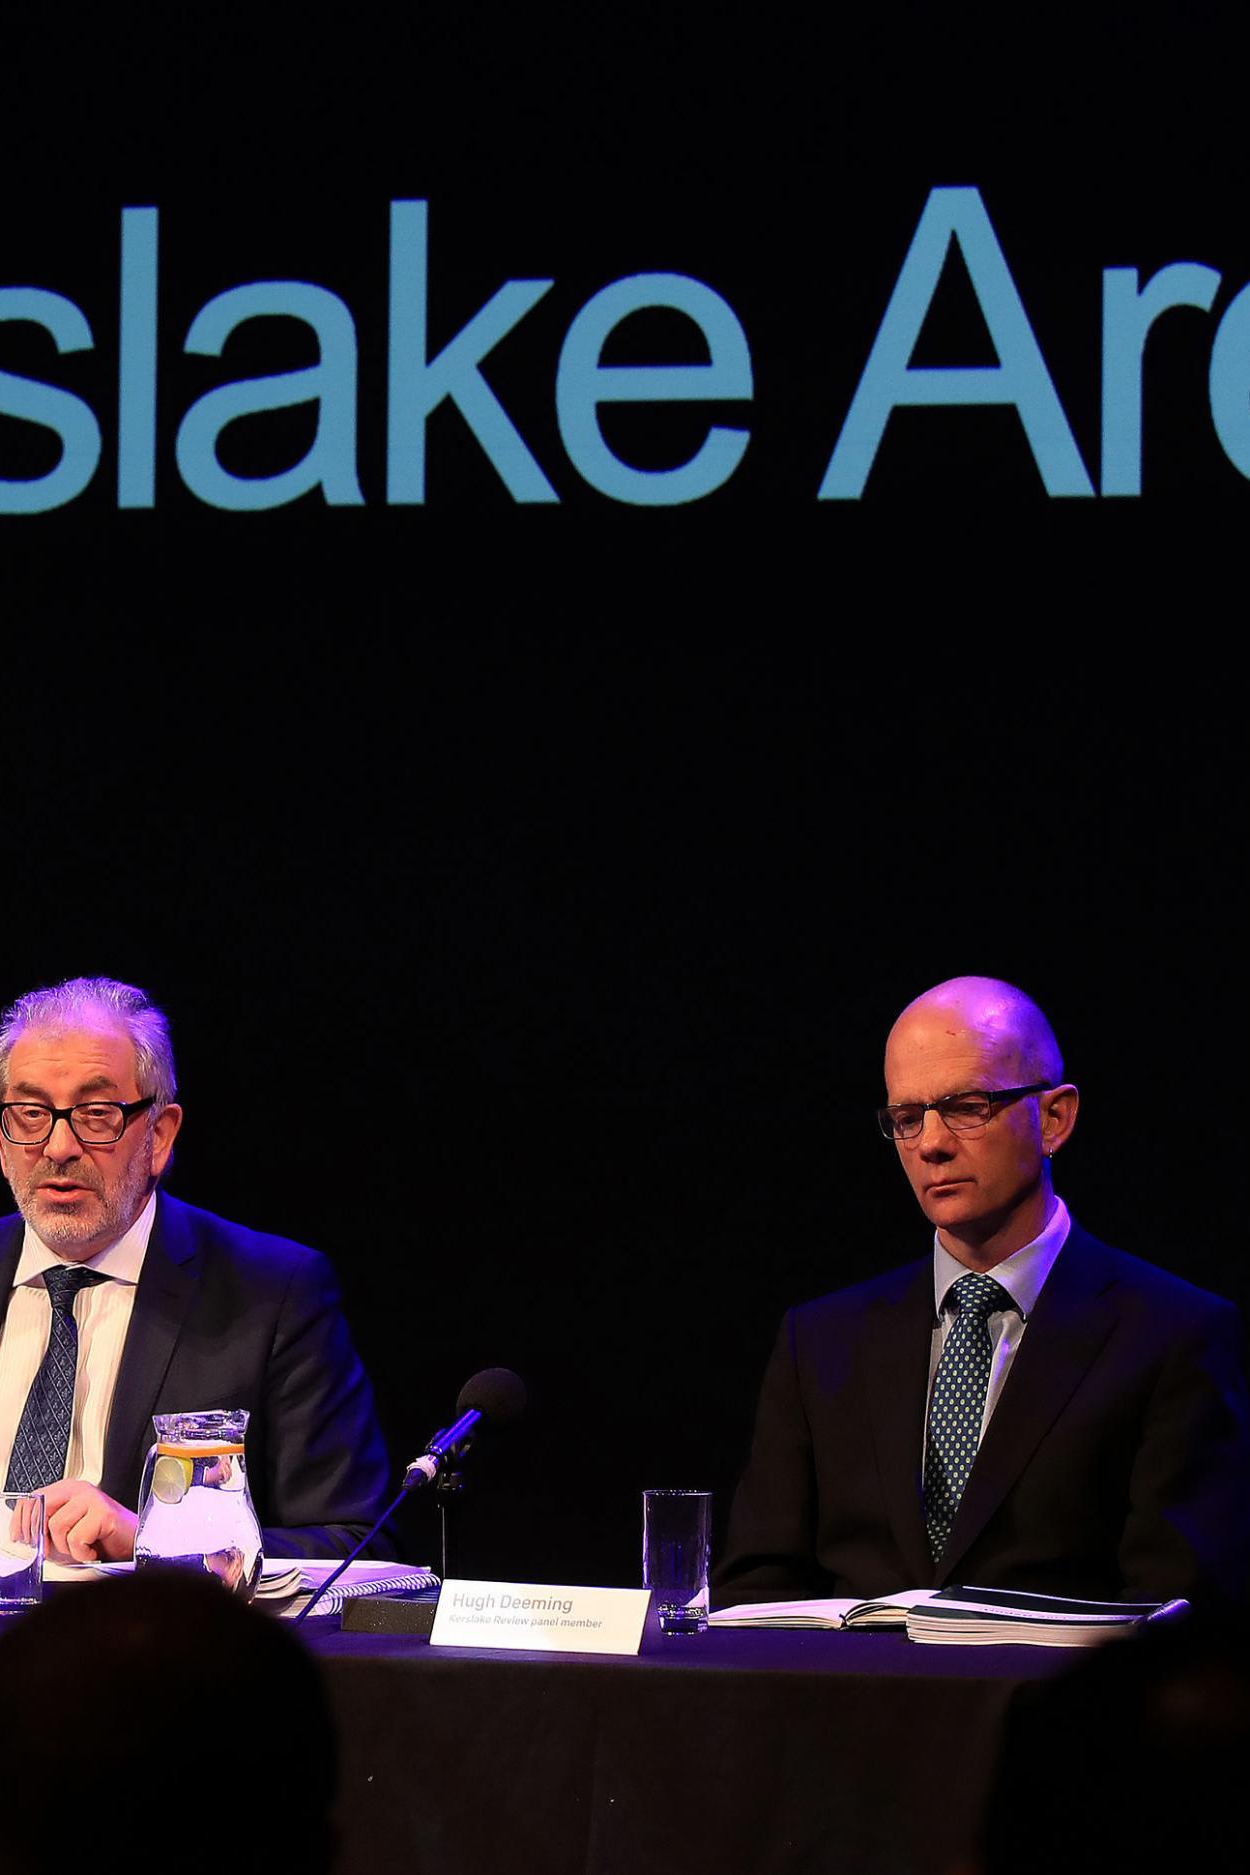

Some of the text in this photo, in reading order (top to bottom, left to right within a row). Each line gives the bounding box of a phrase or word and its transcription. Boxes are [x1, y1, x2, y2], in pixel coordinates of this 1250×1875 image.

[817, 185, 1250, 500] Ar
[453, 1593, 573, 1614] Hugh Deeming
[449, 1614, 603, 1629] Kerslake Review panel member
